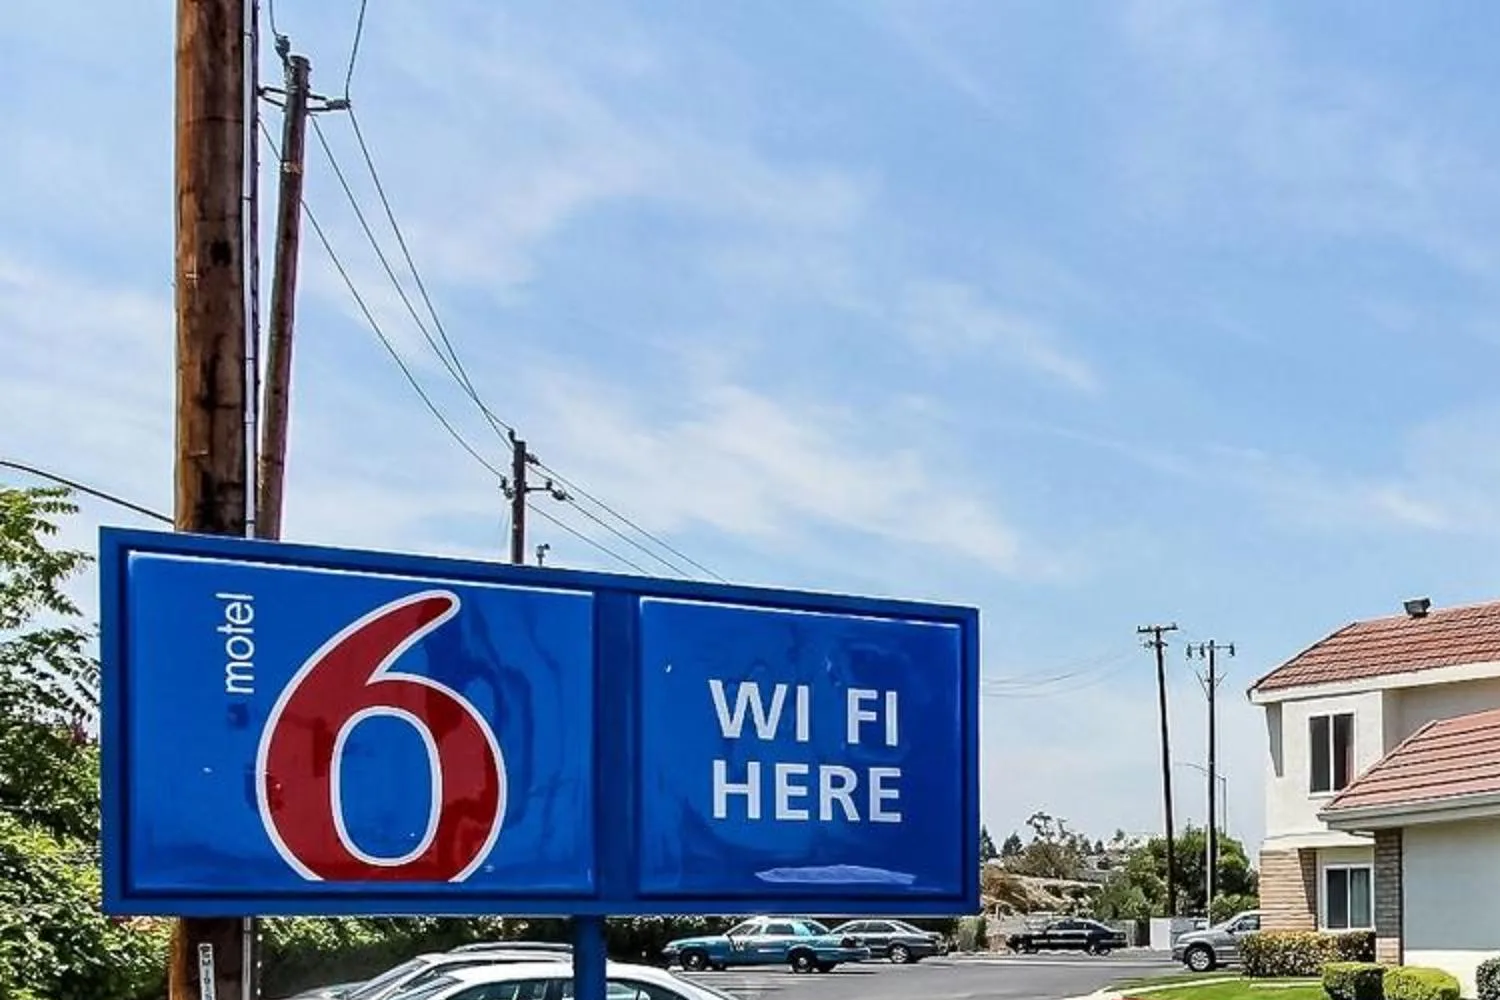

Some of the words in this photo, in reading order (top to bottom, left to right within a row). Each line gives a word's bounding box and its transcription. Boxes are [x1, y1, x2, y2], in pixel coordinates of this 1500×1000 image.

[216, 592, 254, 693] motel
[255, 589, 507, 882] 6
[709, 679, 809, 741] WI
[847, 687, 898, 746] FI
[713, 759, 901, 822] HERE
